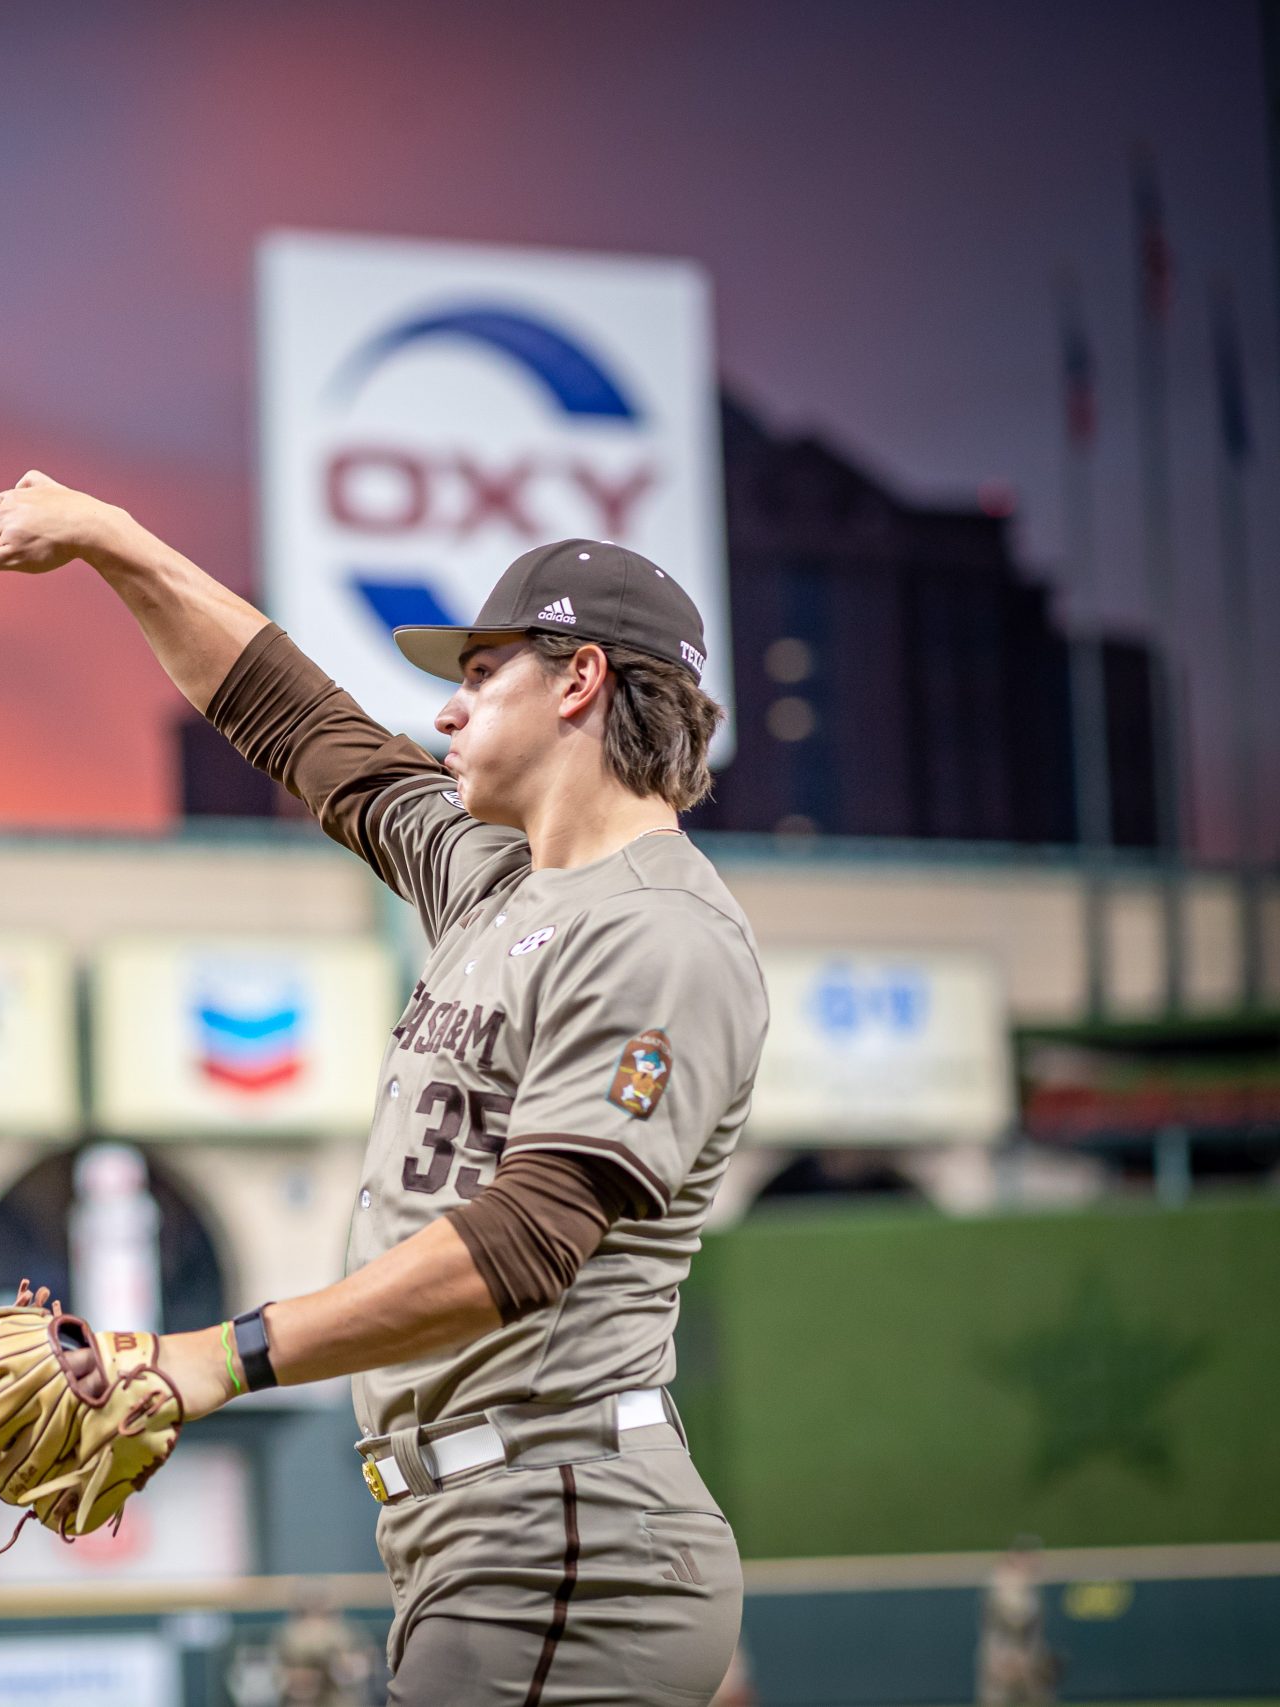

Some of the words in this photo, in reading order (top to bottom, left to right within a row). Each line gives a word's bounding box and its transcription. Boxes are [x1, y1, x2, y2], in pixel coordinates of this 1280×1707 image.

[324, 446, 660, 540] OXY
[537, 610, 577, 625] adidas
[401, 1080, 514, 1200] 35
